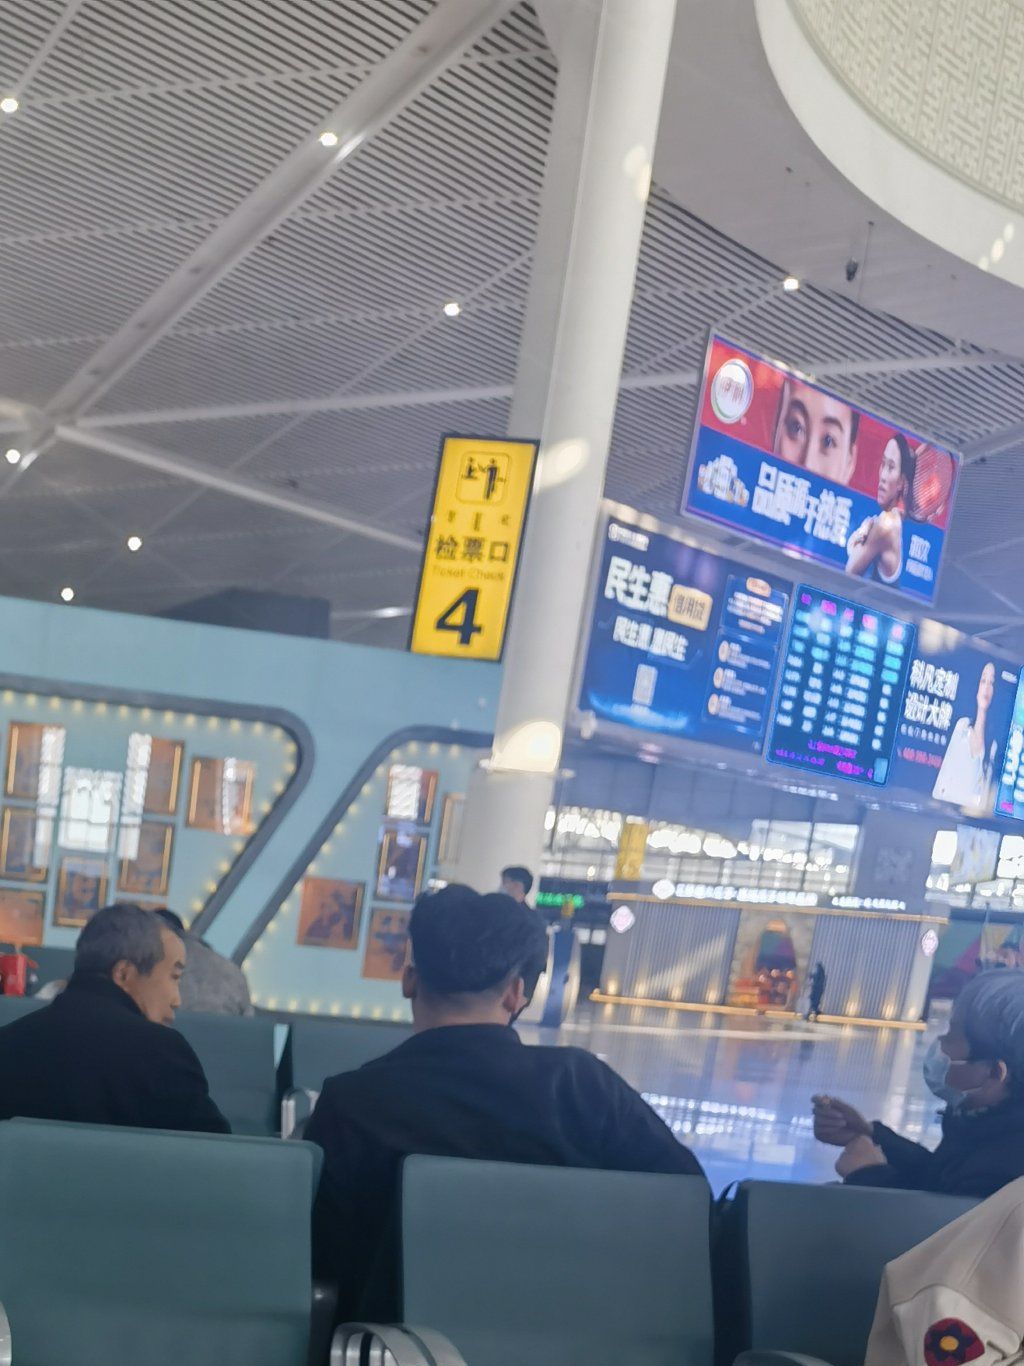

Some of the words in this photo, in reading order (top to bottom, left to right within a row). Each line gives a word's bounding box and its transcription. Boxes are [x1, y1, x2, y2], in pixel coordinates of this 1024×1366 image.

[434, 533, 510, 563] 检票口
[434, 586, 483, 647] 4
[604, 555, 674, 618] 民生惠
